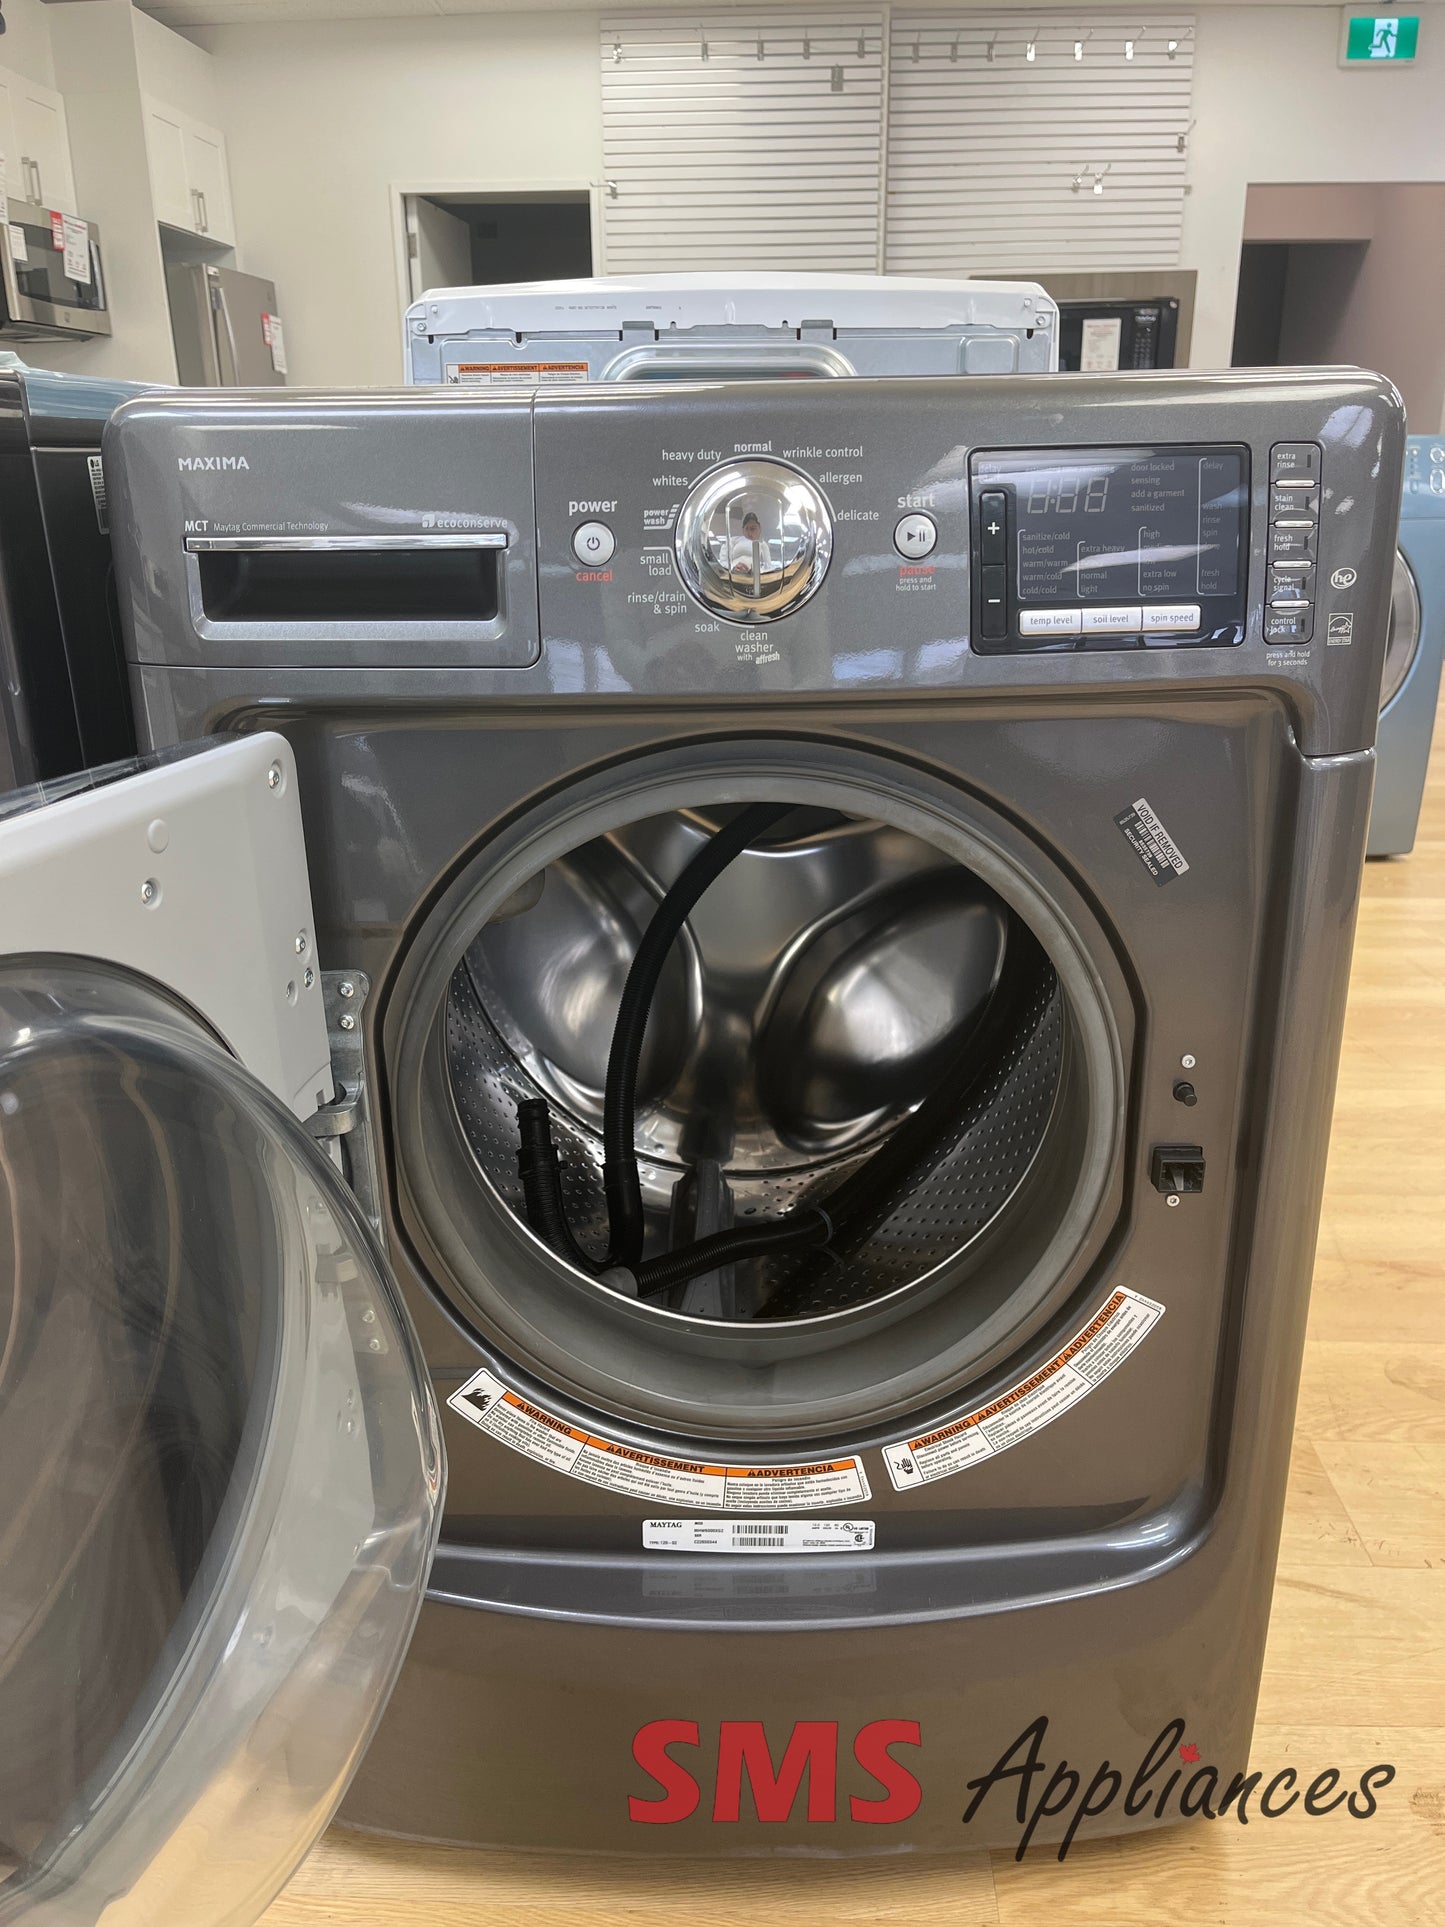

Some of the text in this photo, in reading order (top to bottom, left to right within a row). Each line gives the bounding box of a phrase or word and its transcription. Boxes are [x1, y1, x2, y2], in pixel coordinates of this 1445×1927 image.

[734, 441, 772, 452] normal
[662, 449, 721, 464] heavy duty
[783, 446, 863, 459] wrinkle control
[178, 456, 250, 471] MAXIMA
[1131, 461, 1175, 471] door locked
[1203, 462, 1224, 470] delay
[653, 476, 688, 486] whites
[819, 472, 862, 485] allergen
[1131, 476, 1160, 485] sensing
[1153, 490, 1184, 499] garment
[1275, 494, 1293, 502] stain
[897, 493, 935, 508] start
[569, 500, 617, 516] power
[1132, 503, 1164, 512] sanitized
[644, 510, 669, 518] power
[837, 510, 879, 521] delicate
[185, 520, 328, 532] MCT Maytag Commercial Technology
[437, 519, 508, 528] ecoconserve
[644, 517, 665, 525] wash
[1022, 532, 1070, 541] sanitize/cold
[1144, 530, 1160, 539] high
[1202, 530, 1218, 538] spin
[1274, 534, 1293, 542] fresh
[1022, 545, 1054, 554] hot/cold
[1081, 544, 1125, 553] extra heavy
[1274, 543, 1290, 551] hold
[640, 554, 668, 564] small
[1023, 559, 1068, 568] warm/warm
[649, 564, 672, 576] load
[898, 566, 935, 578] pause
[1081, 571, 1107, 579] normal
[1164, 569, 1177, 577] low
[1201, 569, 1219, 577] fresh
[576, 570, 613, 582] cancel
[1023, 572, 1062, 581] warm/cold
[1273, 576, 1291, 585] cycle
[1022, 585, 1057, 594] cold/cold
[1081, 585, 1098, 594] light
[1153, 583, 1169, 592] spin
[1201, 582, 1217, 590] hold
[1273, 584, 1295, 592] signal
[628, 591, 686, 603] rinse/drain
[654, 602, 687, 616] & spin
[1030, 615, 1073, 625] temp level
[1093, 614, 1128, 623] soil level
[1150, 612, 1194, 623] spin speed
[1271, 617, 1296, 625] control
[695, 621, 720, 632] soak
[740, 630, 768, 640] clean
[735, 642, 774, 653] washer
[737, 651, 780, 664] with affresh
[1284, 650, 1296, 658] and
[1137, 804, 1154, 825] VOID
[1150, 822, 1160, 832] IF
[1155, 832, 1183, 869] REMOVED
[1124, 828, 1145, 855] SECURITY
[1142, 854, 1158, 876] SEALED
[1069, 1294, 1123, 1355] ADVERTENCIA
[985, 1360, 1060, 1414] AVERTISSEMENT
[524, 1408, 572, 1434] WARNING
[921, 1420, 970, 1445] WARNING
[614, 1447, 704, 1473] AVERTISSEMENT
[757, 1465, 835, 1477] ADVERTENCIA
